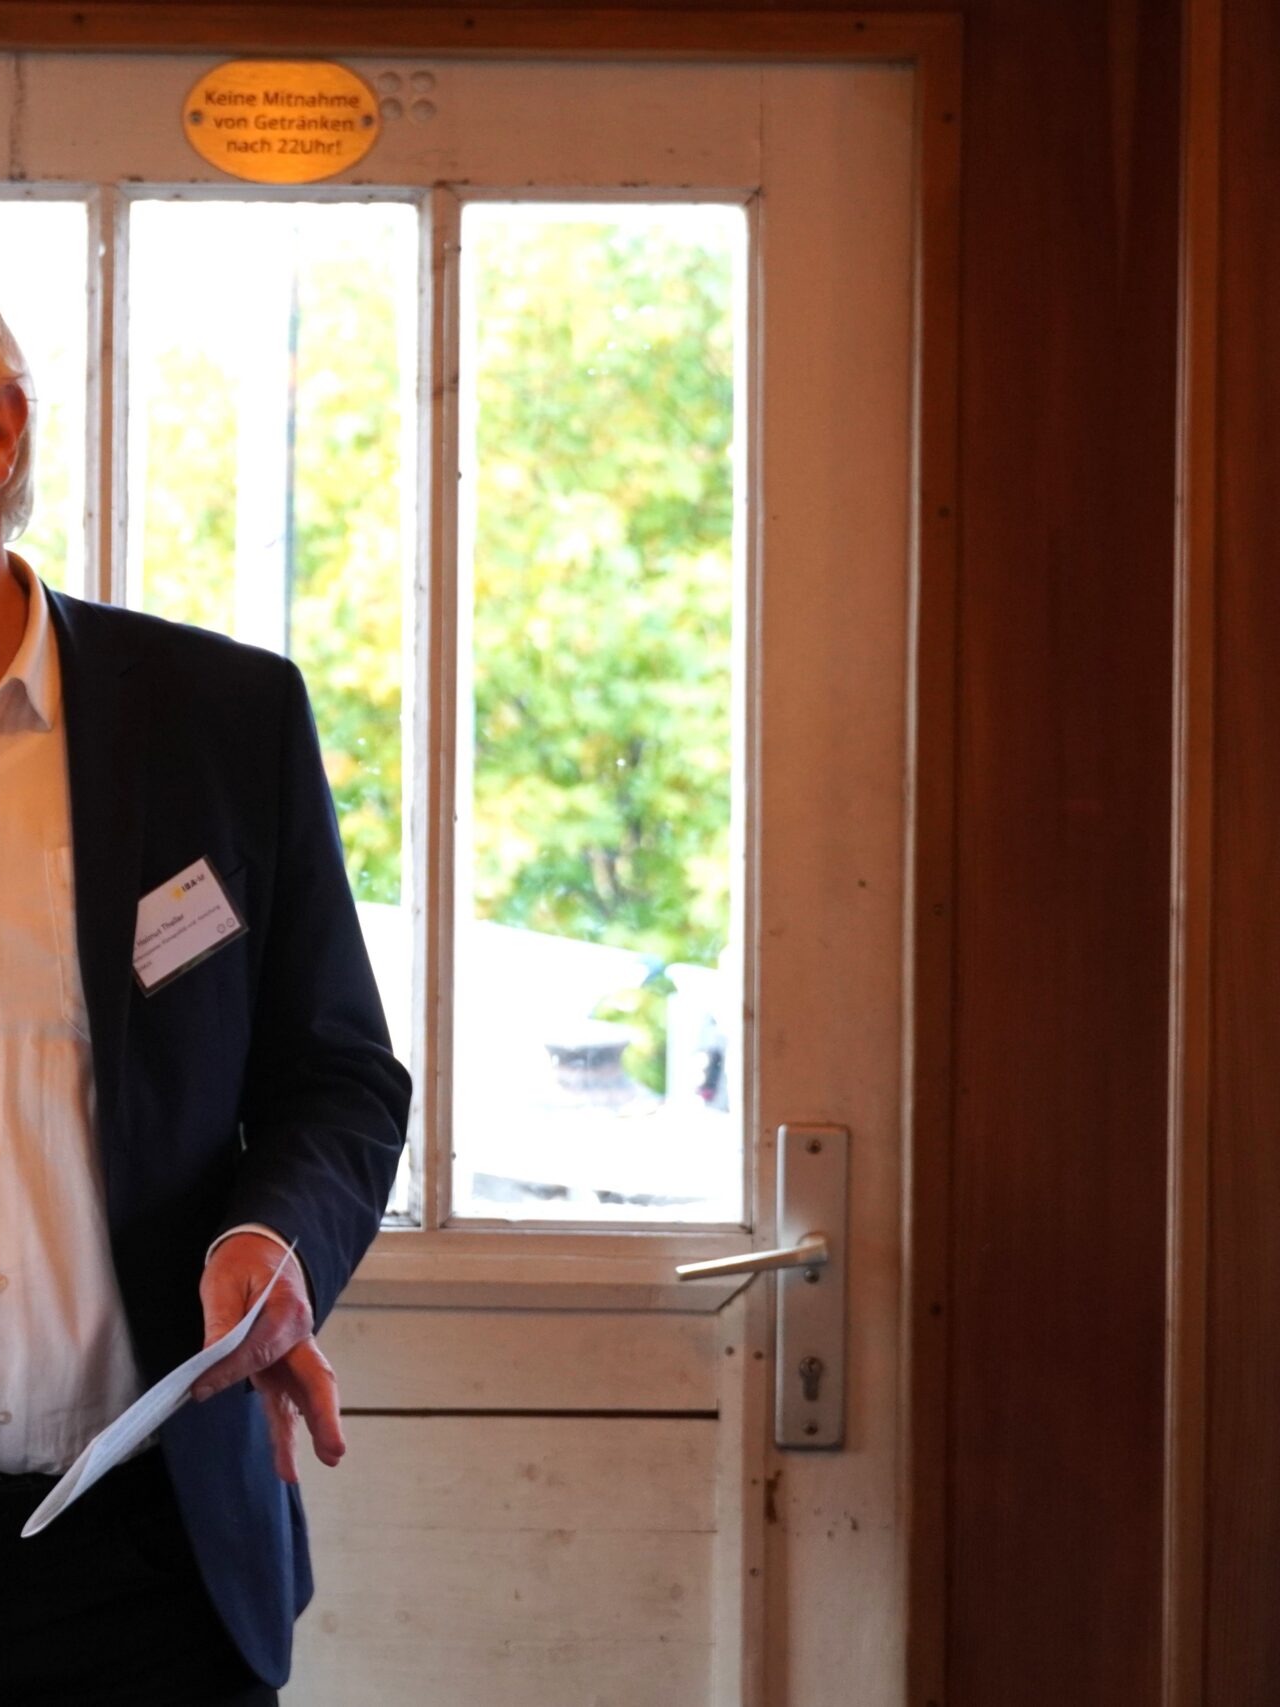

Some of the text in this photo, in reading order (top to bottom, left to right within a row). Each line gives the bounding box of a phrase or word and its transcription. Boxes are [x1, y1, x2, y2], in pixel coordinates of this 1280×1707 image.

[204, 90, 360, 109] Keine Mitnahme
[213, 113, 355, 132] von Getränken
[226, 139, 342, 155] nach 22Uhr!
